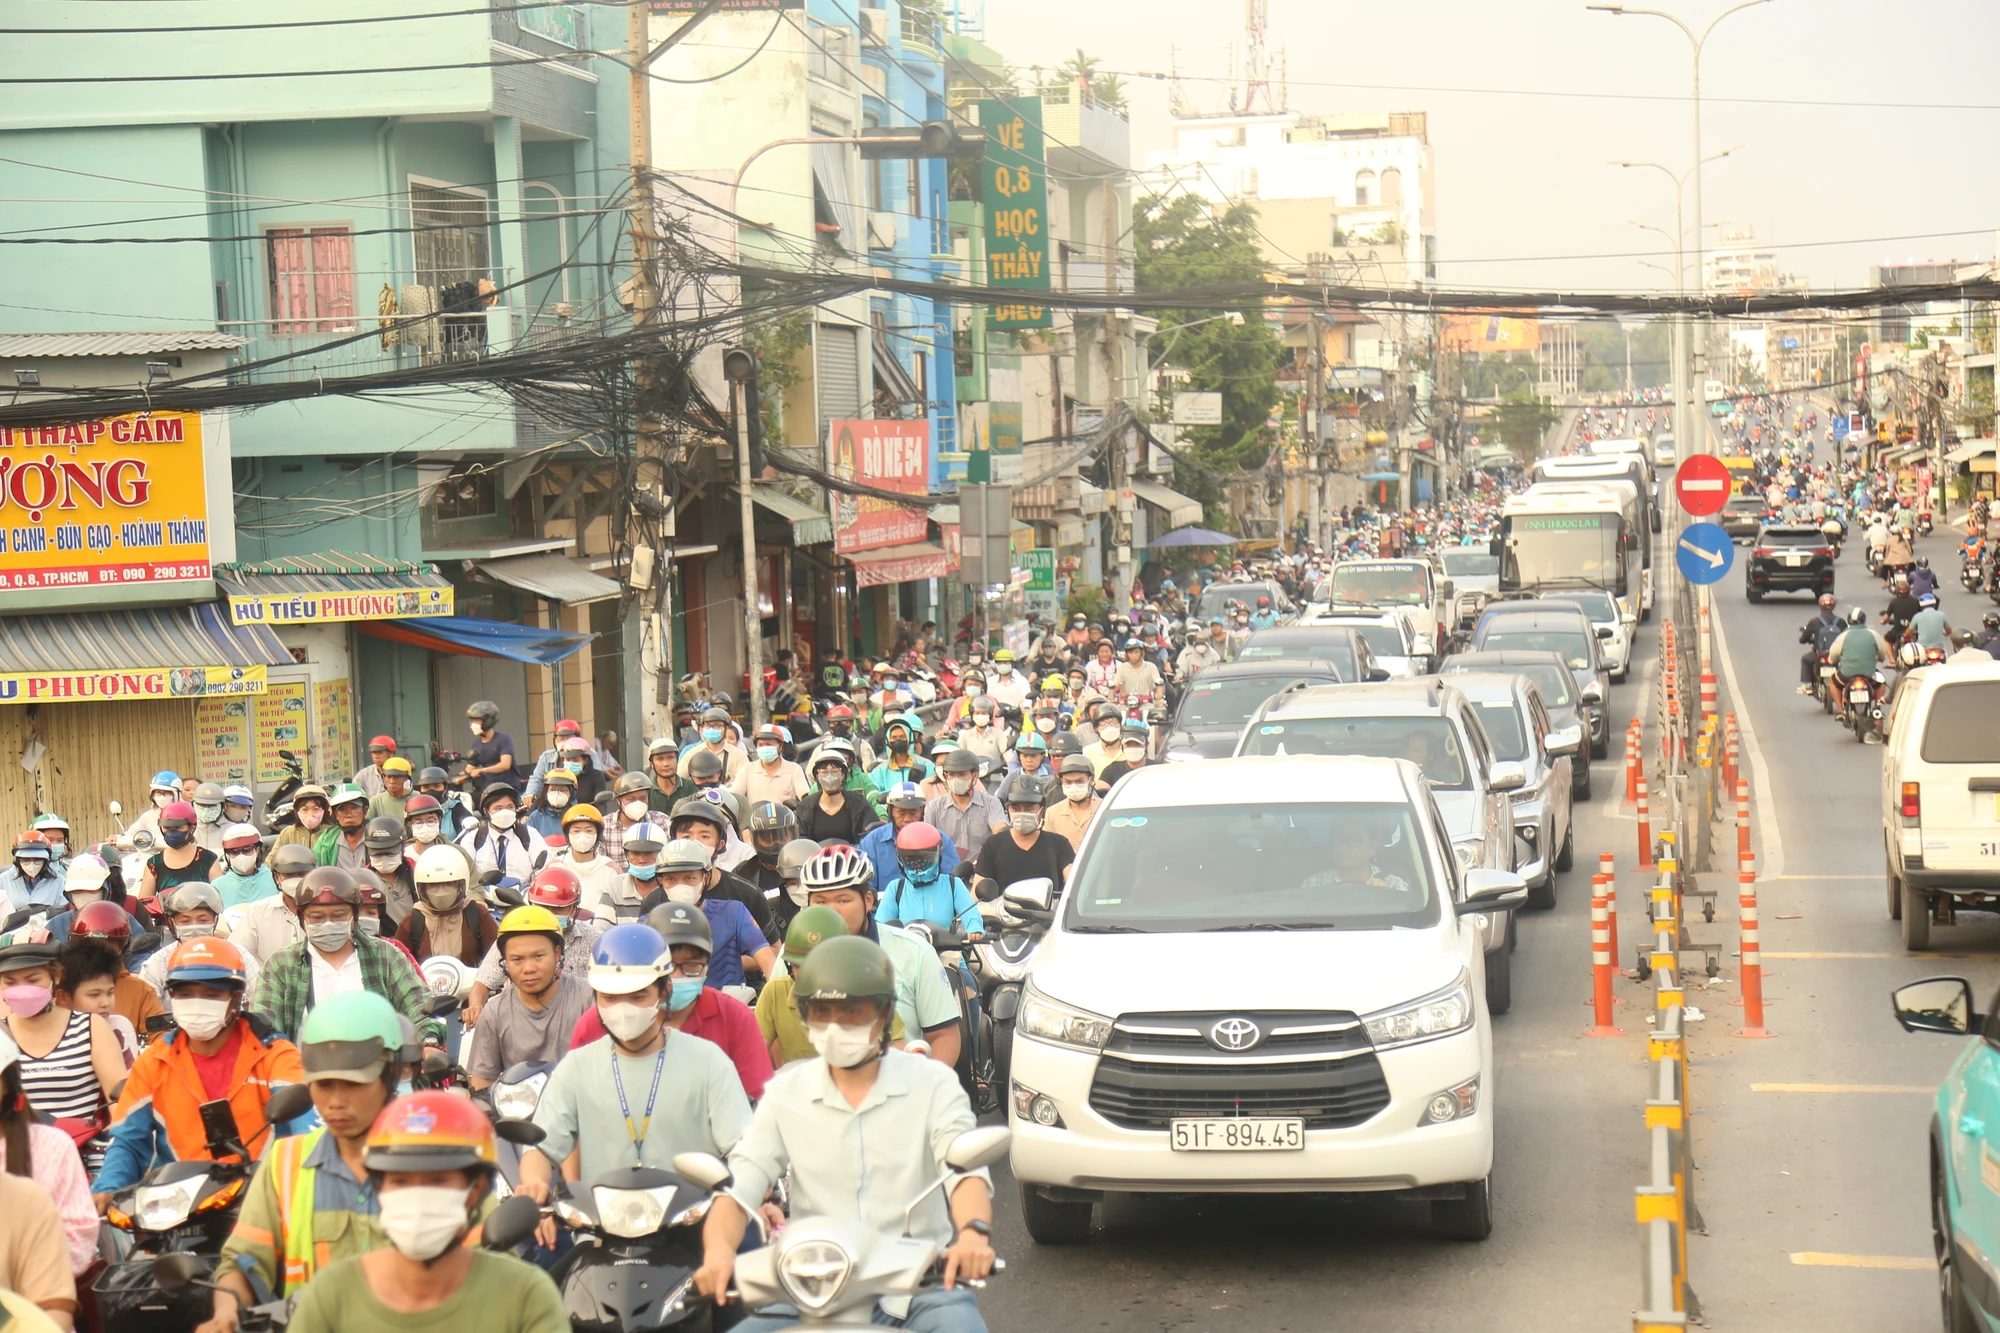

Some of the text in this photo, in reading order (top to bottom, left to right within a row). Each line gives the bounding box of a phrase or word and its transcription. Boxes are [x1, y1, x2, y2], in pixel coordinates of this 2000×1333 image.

[995, 166, 1031, 198] Q.8
[995, 208, 1038, 242] HỌC
[990, 242, 1042, 279] THẦY
[862, 424, 922, 479] BÒ NÉ 54
[12, 527, 46, 553] CANH
[56, 521, 82, 550] BÚN
[88, 524, 112, 554] GẠO
[122, 518, 163, 548] HOÀNH
[167, 516, 206, 545] THÁNH
[43, 570, 89, 585] TP.HCM
[99, 570, 118, 582] ĐT:
[123, 568, 146, 580] 090
[154, 566, 177, 578] 290
[179, 564, 208, 578] 3211
[235, 596, 395, 621] HỦ TIẾU PHƯỢNG
[27, 672, 164, 700] PHƯỢNG
[208, 680, 264, 694] 0902 290 3211
[1980, 843, 2000, 856] 51
[810, 989, 847, 1000] Andes
